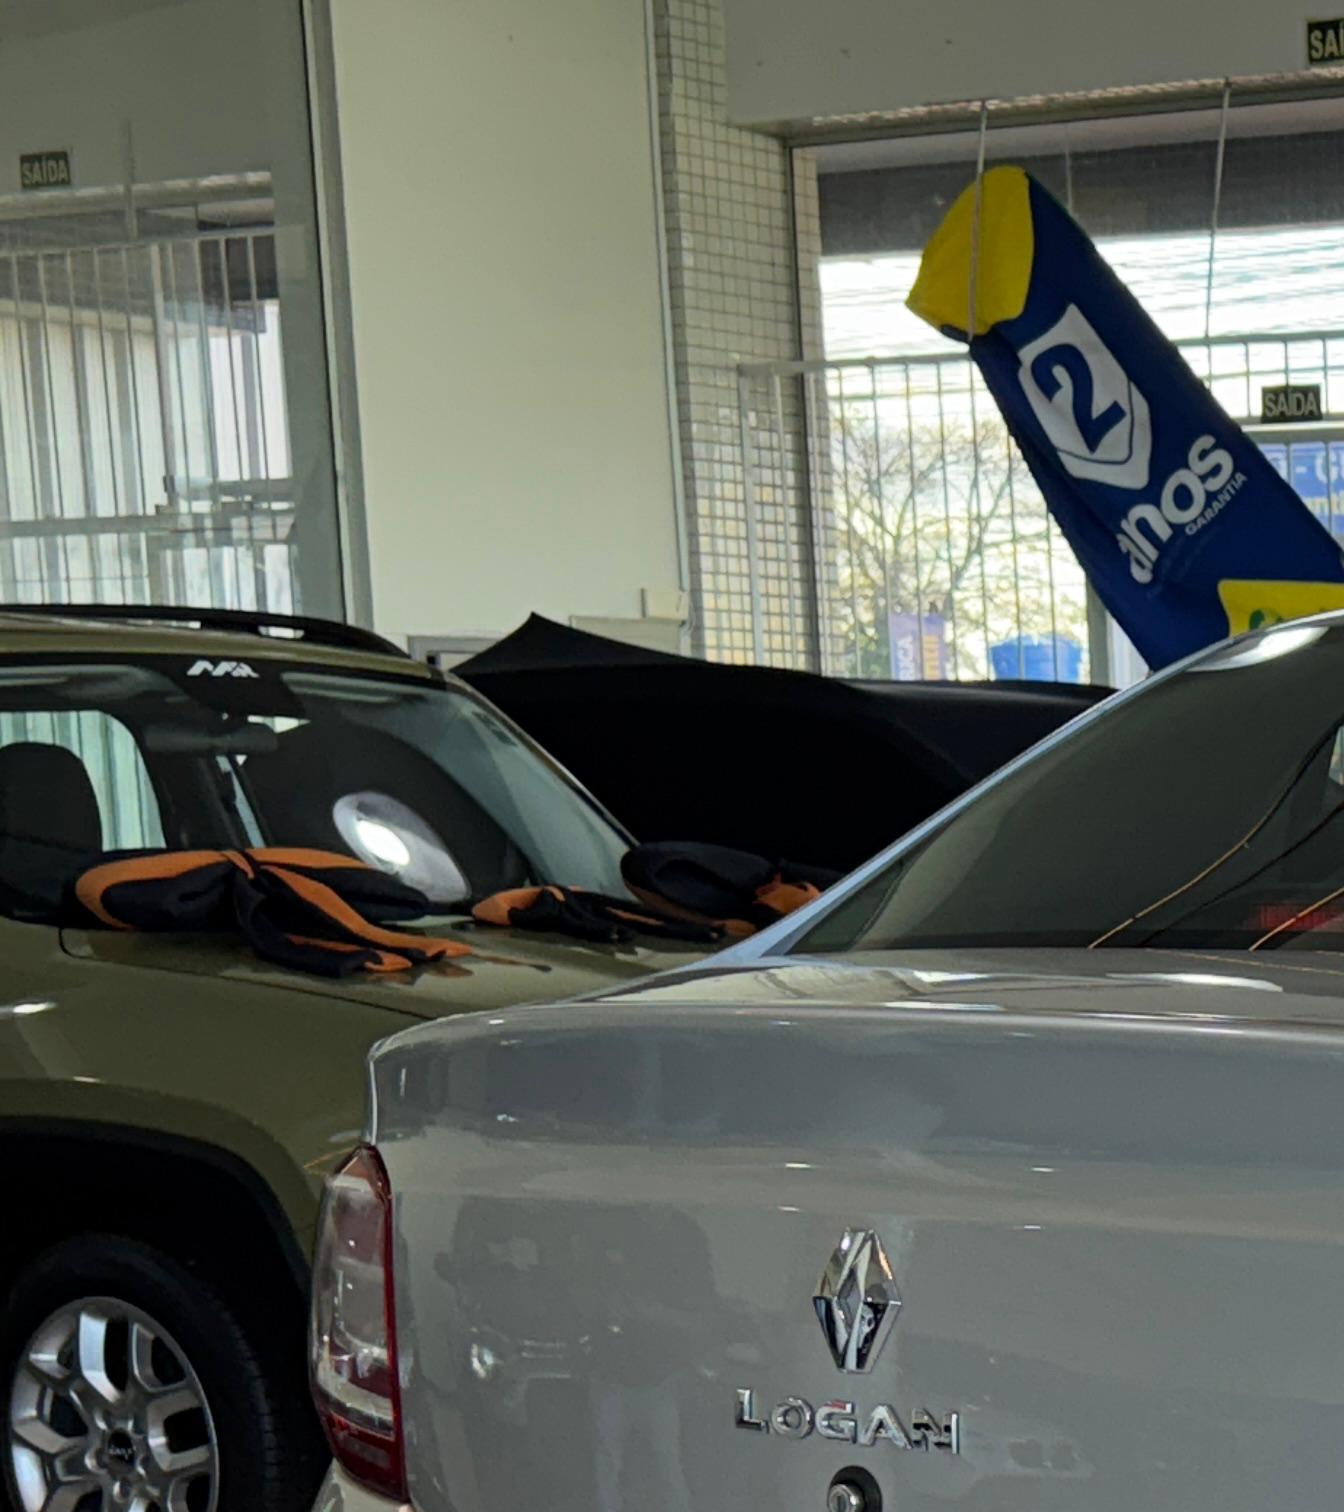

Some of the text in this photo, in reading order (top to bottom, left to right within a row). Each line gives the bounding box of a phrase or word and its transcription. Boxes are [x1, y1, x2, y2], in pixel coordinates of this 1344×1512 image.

[22, 156, 69, 185] SAÍDA
[1031, 343, 1127, 454] 2
[1265, 387, 1319, 417] SAÍDA
[1185, 471, 1248, 537] GARANTIA
[735, 1388, 960, 1455] LOGAN
